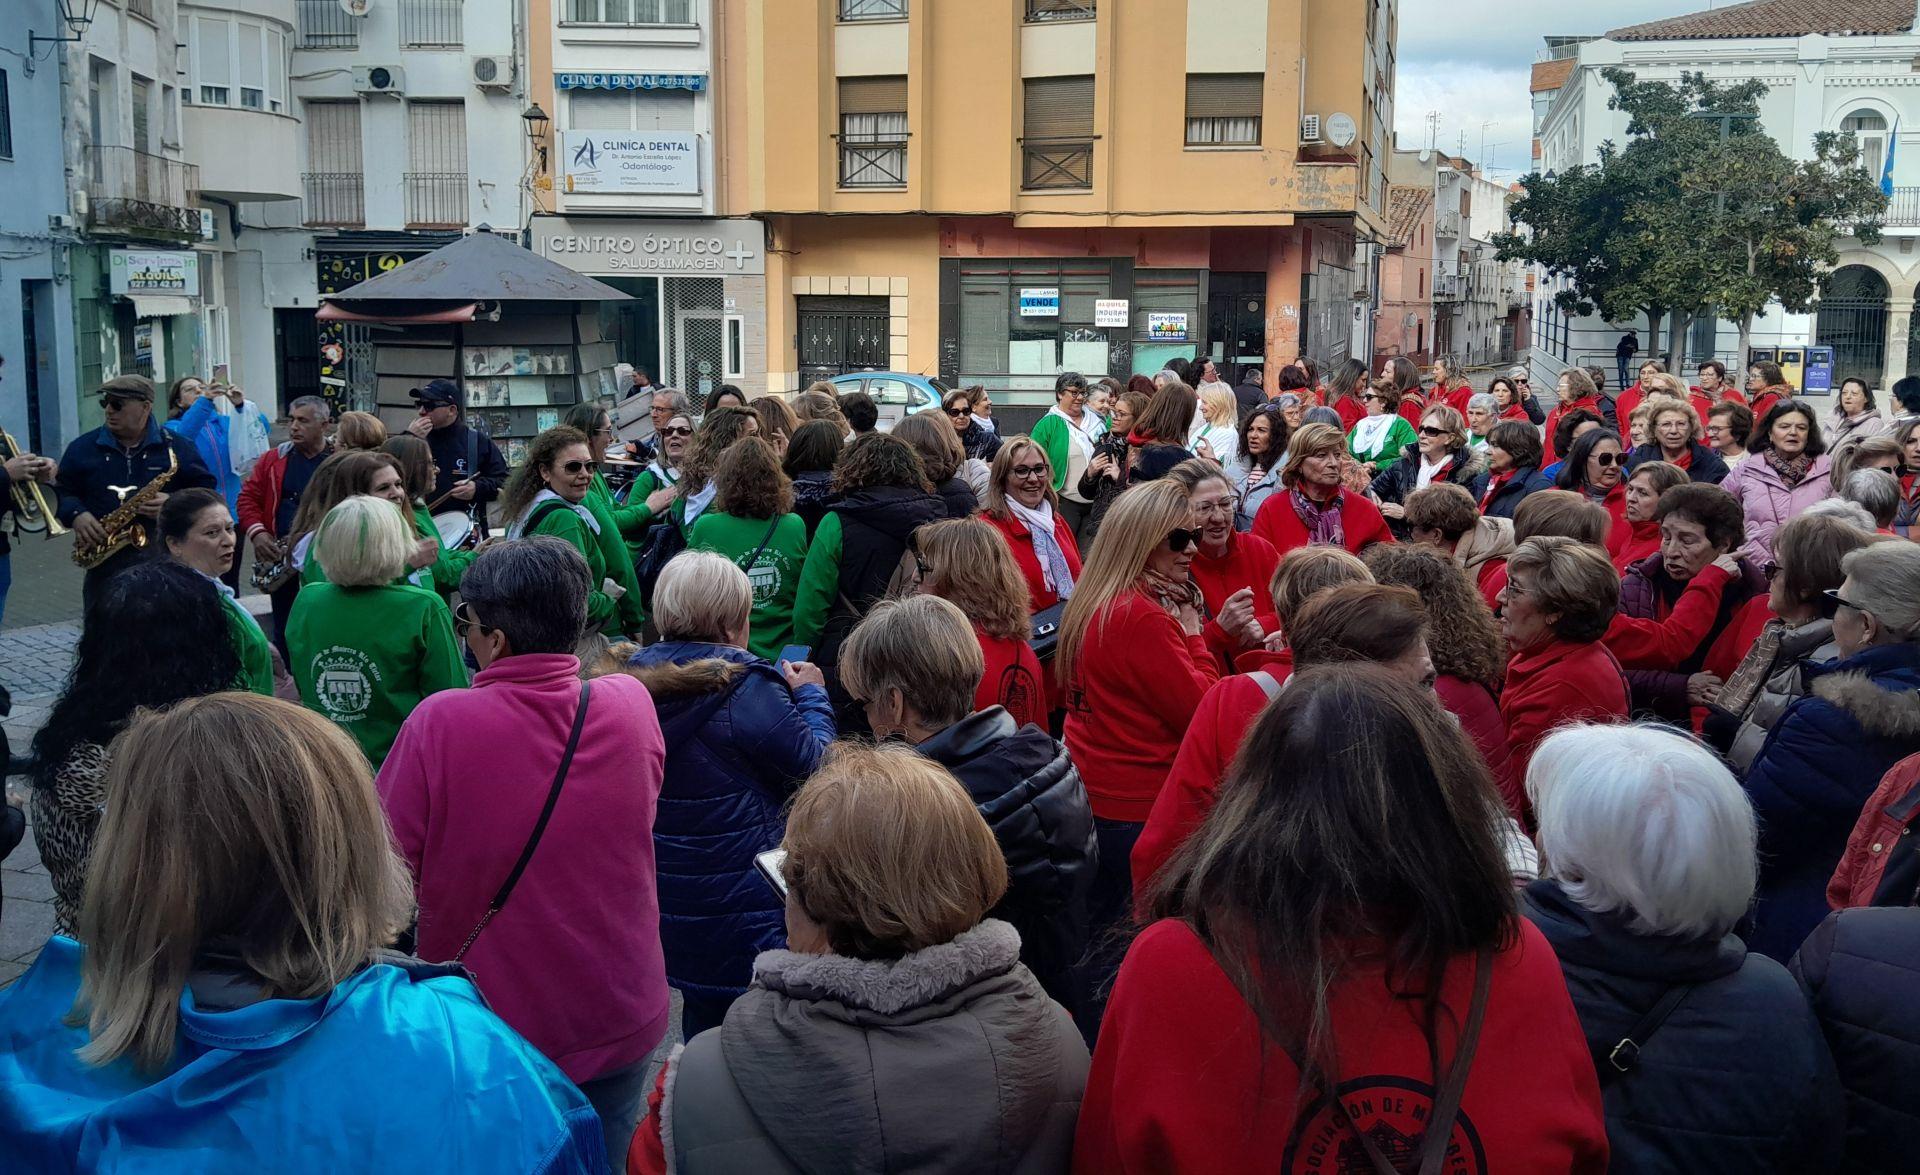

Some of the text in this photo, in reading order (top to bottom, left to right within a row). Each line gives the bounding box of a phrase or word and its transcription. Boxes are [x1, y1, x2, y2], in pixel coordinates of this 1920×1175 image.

[560, 75, 608, 85] CLINICA
[612, 76, 657, 85] DENTAL
[649, 142, 690, 152] DENTAL
[550, 233, 724, 255] CENTRO ÓPTICO
[609, 256, 725, 270] SALUD&IMAGEN
[131, 271, 183, 280] ALQUILA
[1025, 298, 1054, 307] VENDE
[1151, 323, 1184, 331] ALQUILA
[1382, 1095, 1404, 1114] DE
